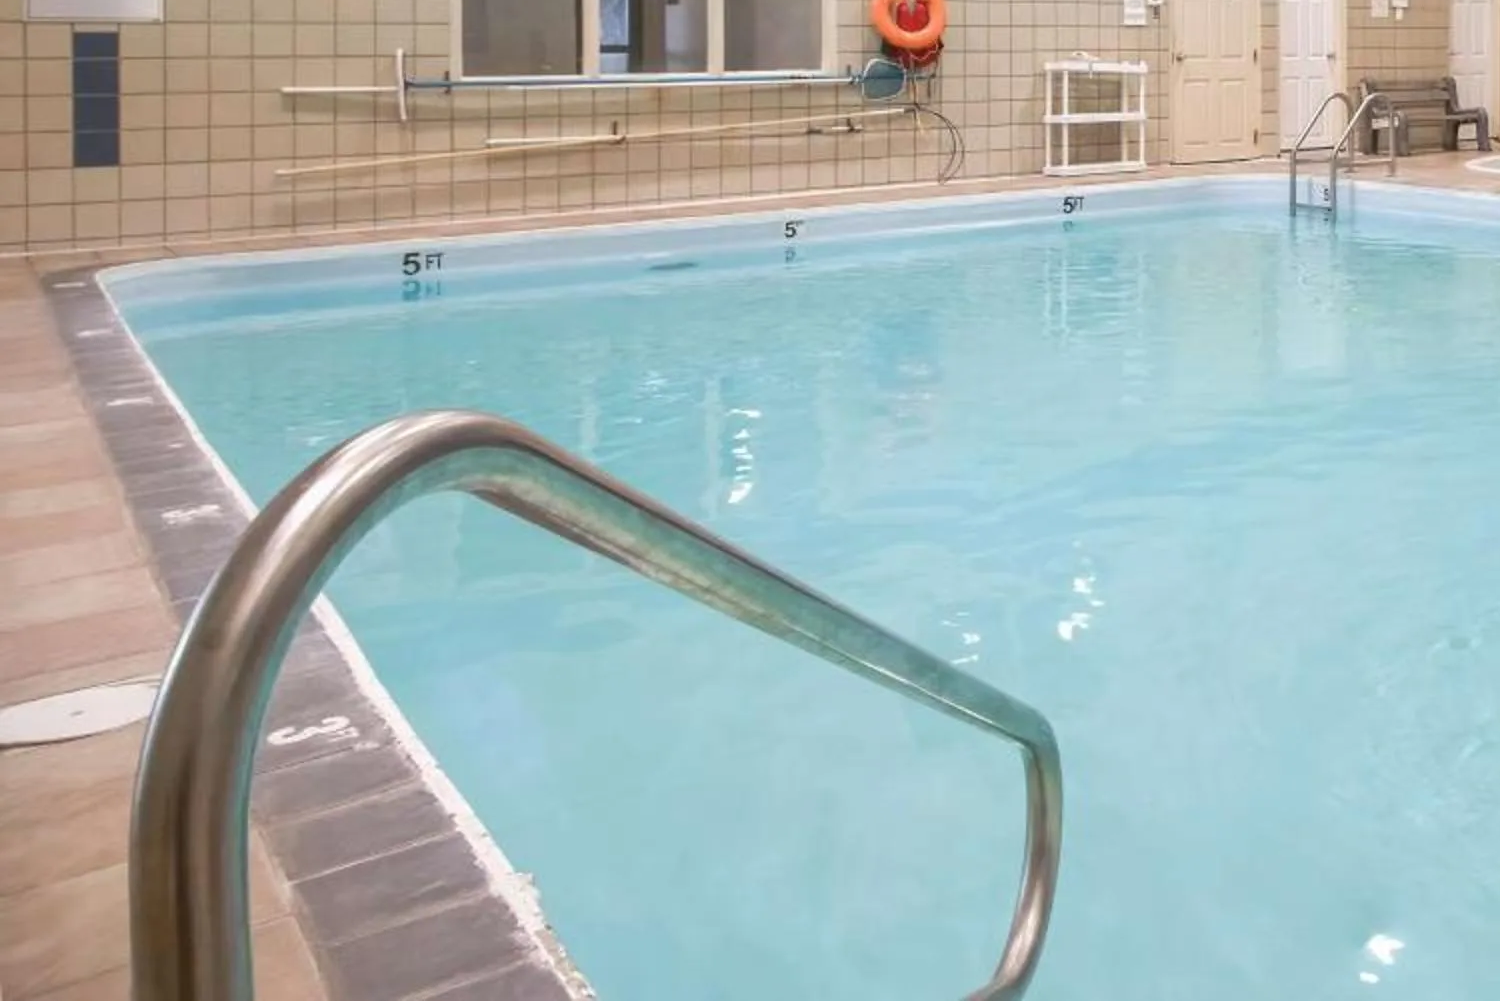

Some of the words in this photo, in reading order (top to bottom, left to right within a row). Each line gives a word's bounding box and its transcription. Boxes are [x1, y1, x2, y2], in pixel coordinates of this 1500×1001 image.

[784, 220, 798, 238] 5
[402, 252, 421, 276] 5
[425, 253, 444, 270] FT
